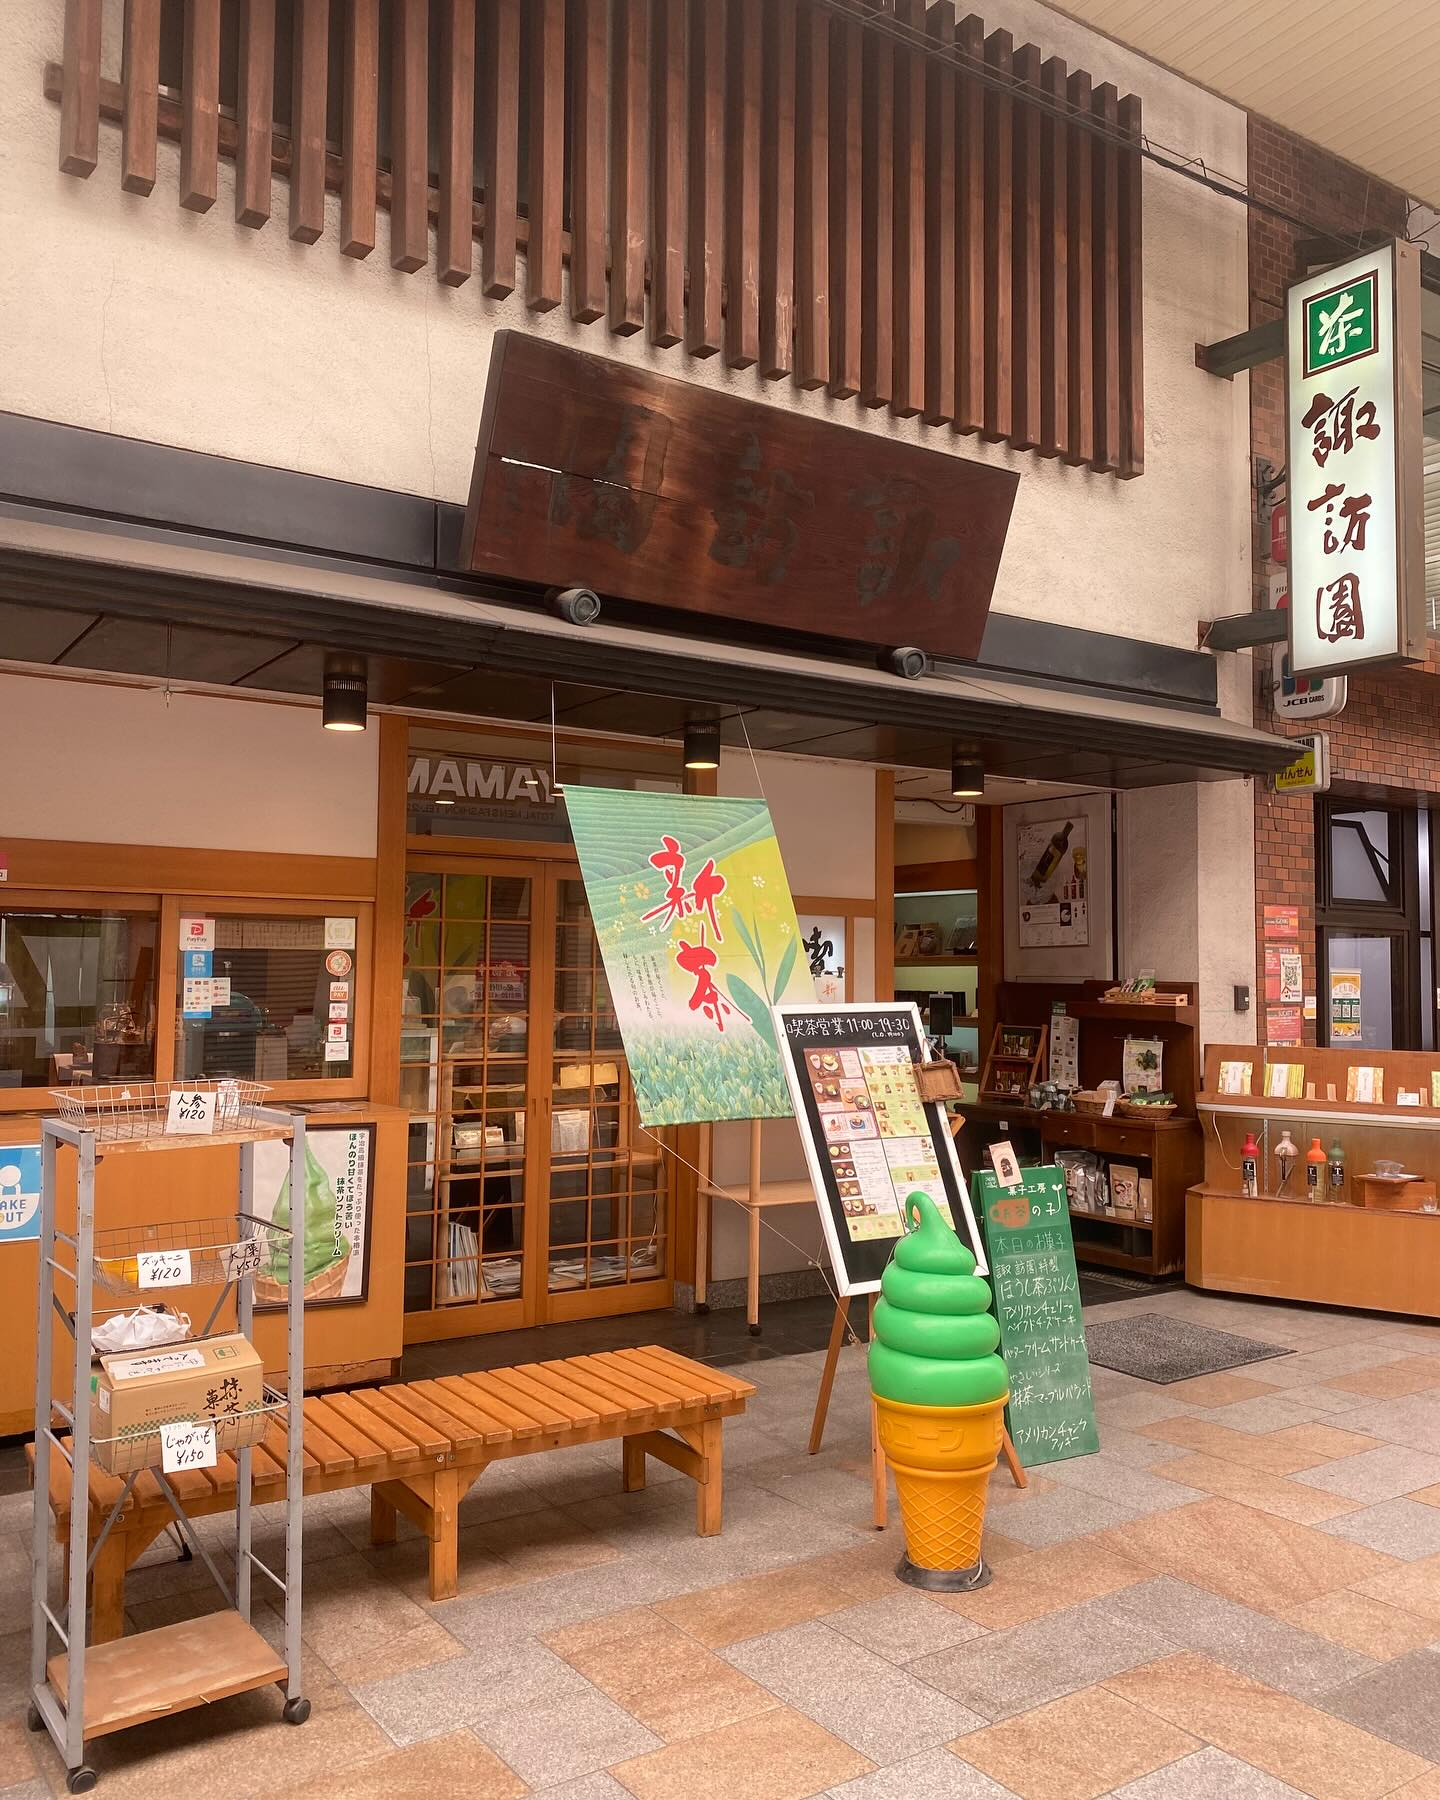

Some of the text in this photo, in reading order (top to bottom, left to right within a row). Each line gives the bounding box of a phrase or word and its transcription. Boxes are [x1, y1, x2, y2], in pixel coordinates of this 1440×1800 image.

[1317, 292, 1364, 356] 茶
[1301, 385, 1381, 644] 諏訪園
[1282, 694, 1325, 707] JCB CARDS
[641, 835, 751, 1032] 新茶
[786, 1017, 910, 1037] 喫茶営業 11:00-19:30
[177, 1094, 207, 1108] 人参
[179, 1108, 206, 1119] ¥120
[344, 1132, 358, 1229] ほんのり甘くてほろ苦い
[1008, 1183, 1046, 1196] 菓子工房
[332, 1177, 346, 1256] 抹茶ソフトクリーム
[995, 1232, 1065, 1254] 本日のお菓子
[141, 1255, 184, 1266] ズッキーニ
[236, 1257, 261, 1276] ¥50
[150, 1267, 181, 1281] ¥120
[1003, 1299, 1074, 1320] アメリカンチェリーの
[1010, 1361, 1064, 1384] やさしいシリーズ
[166, 1428, 211, 1449] じゃがいも
[1051, 1436, 1080, 1452] クッキー
[177, 1449, 204, 1466] ¥150
